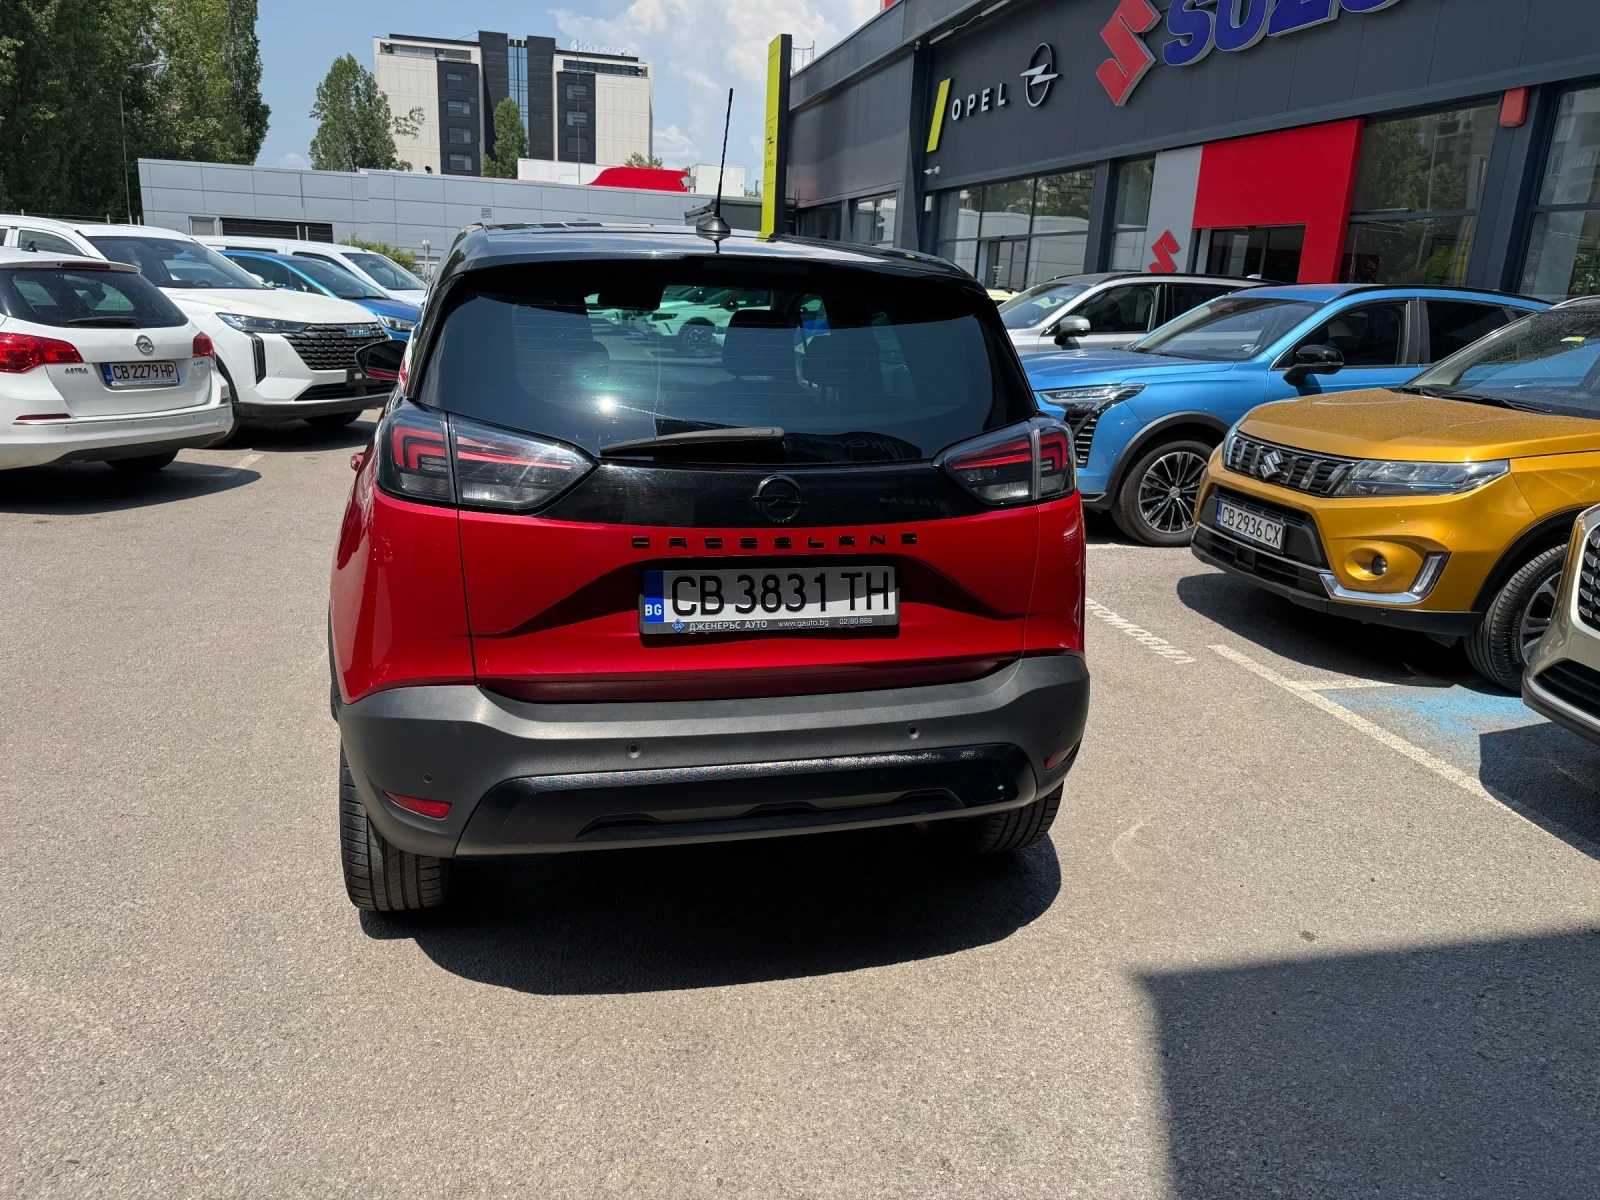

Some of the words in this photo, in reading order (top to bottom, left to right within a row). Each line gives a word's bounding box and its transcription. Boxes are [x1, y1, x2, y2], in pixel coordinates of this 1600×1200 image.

[951, 82, 1006, 120] OPEL
[64, 367, 89, 375] ASTRA
[130, 364, 159, 379] 2279
[1235, 512, 1263, 538] 2936
[631, 532, 918, 549] CROSSLAND
[734, 572, 828, 615] 3831
[645, 603, 663, 617] BG
[689, 621, 741, 632] ДЖЕНЕРЪС
[744, 620, 768, 629] АУТО
[777, 618, 829, 629] www.gauto.bg
[859, 617, 873, 625] 888
